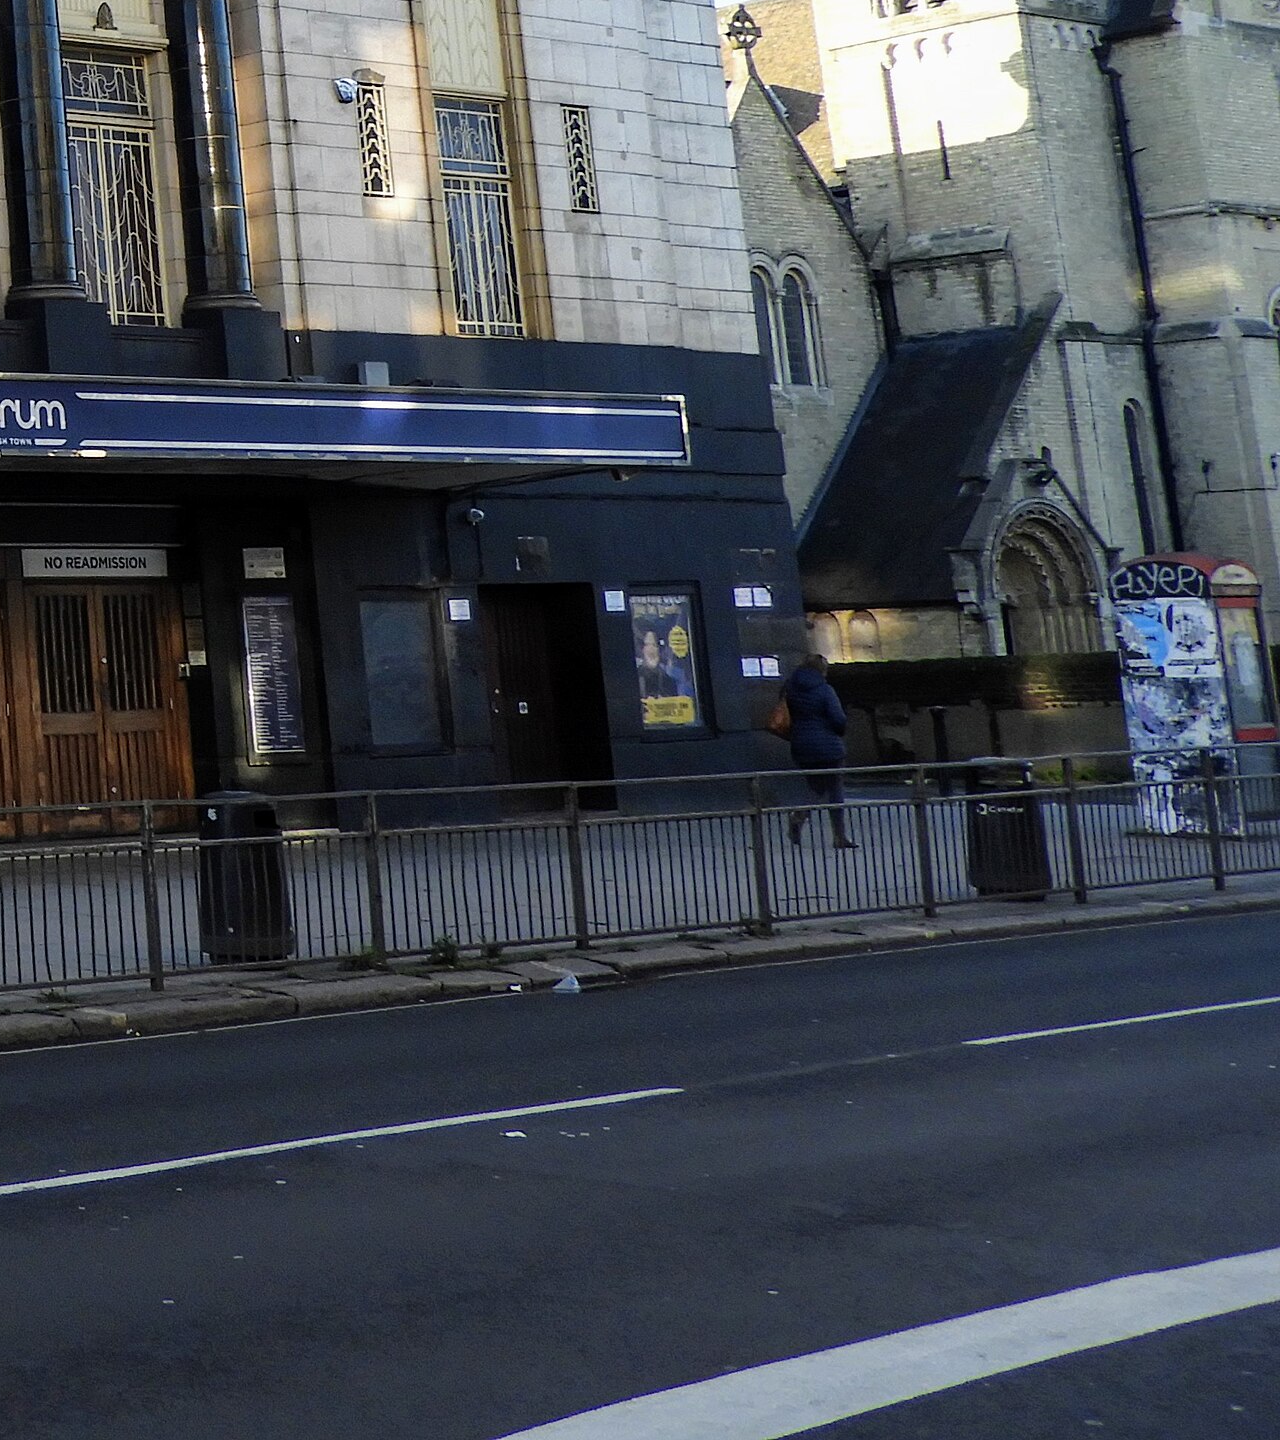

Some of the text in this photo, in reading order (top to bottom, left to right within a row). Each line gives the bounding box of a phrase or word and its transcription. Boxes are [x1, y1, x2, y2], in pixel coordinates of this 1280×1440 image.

[9, 437, 33, 446] TOWN
[44, 557, 147, 569] NO READMISSION
